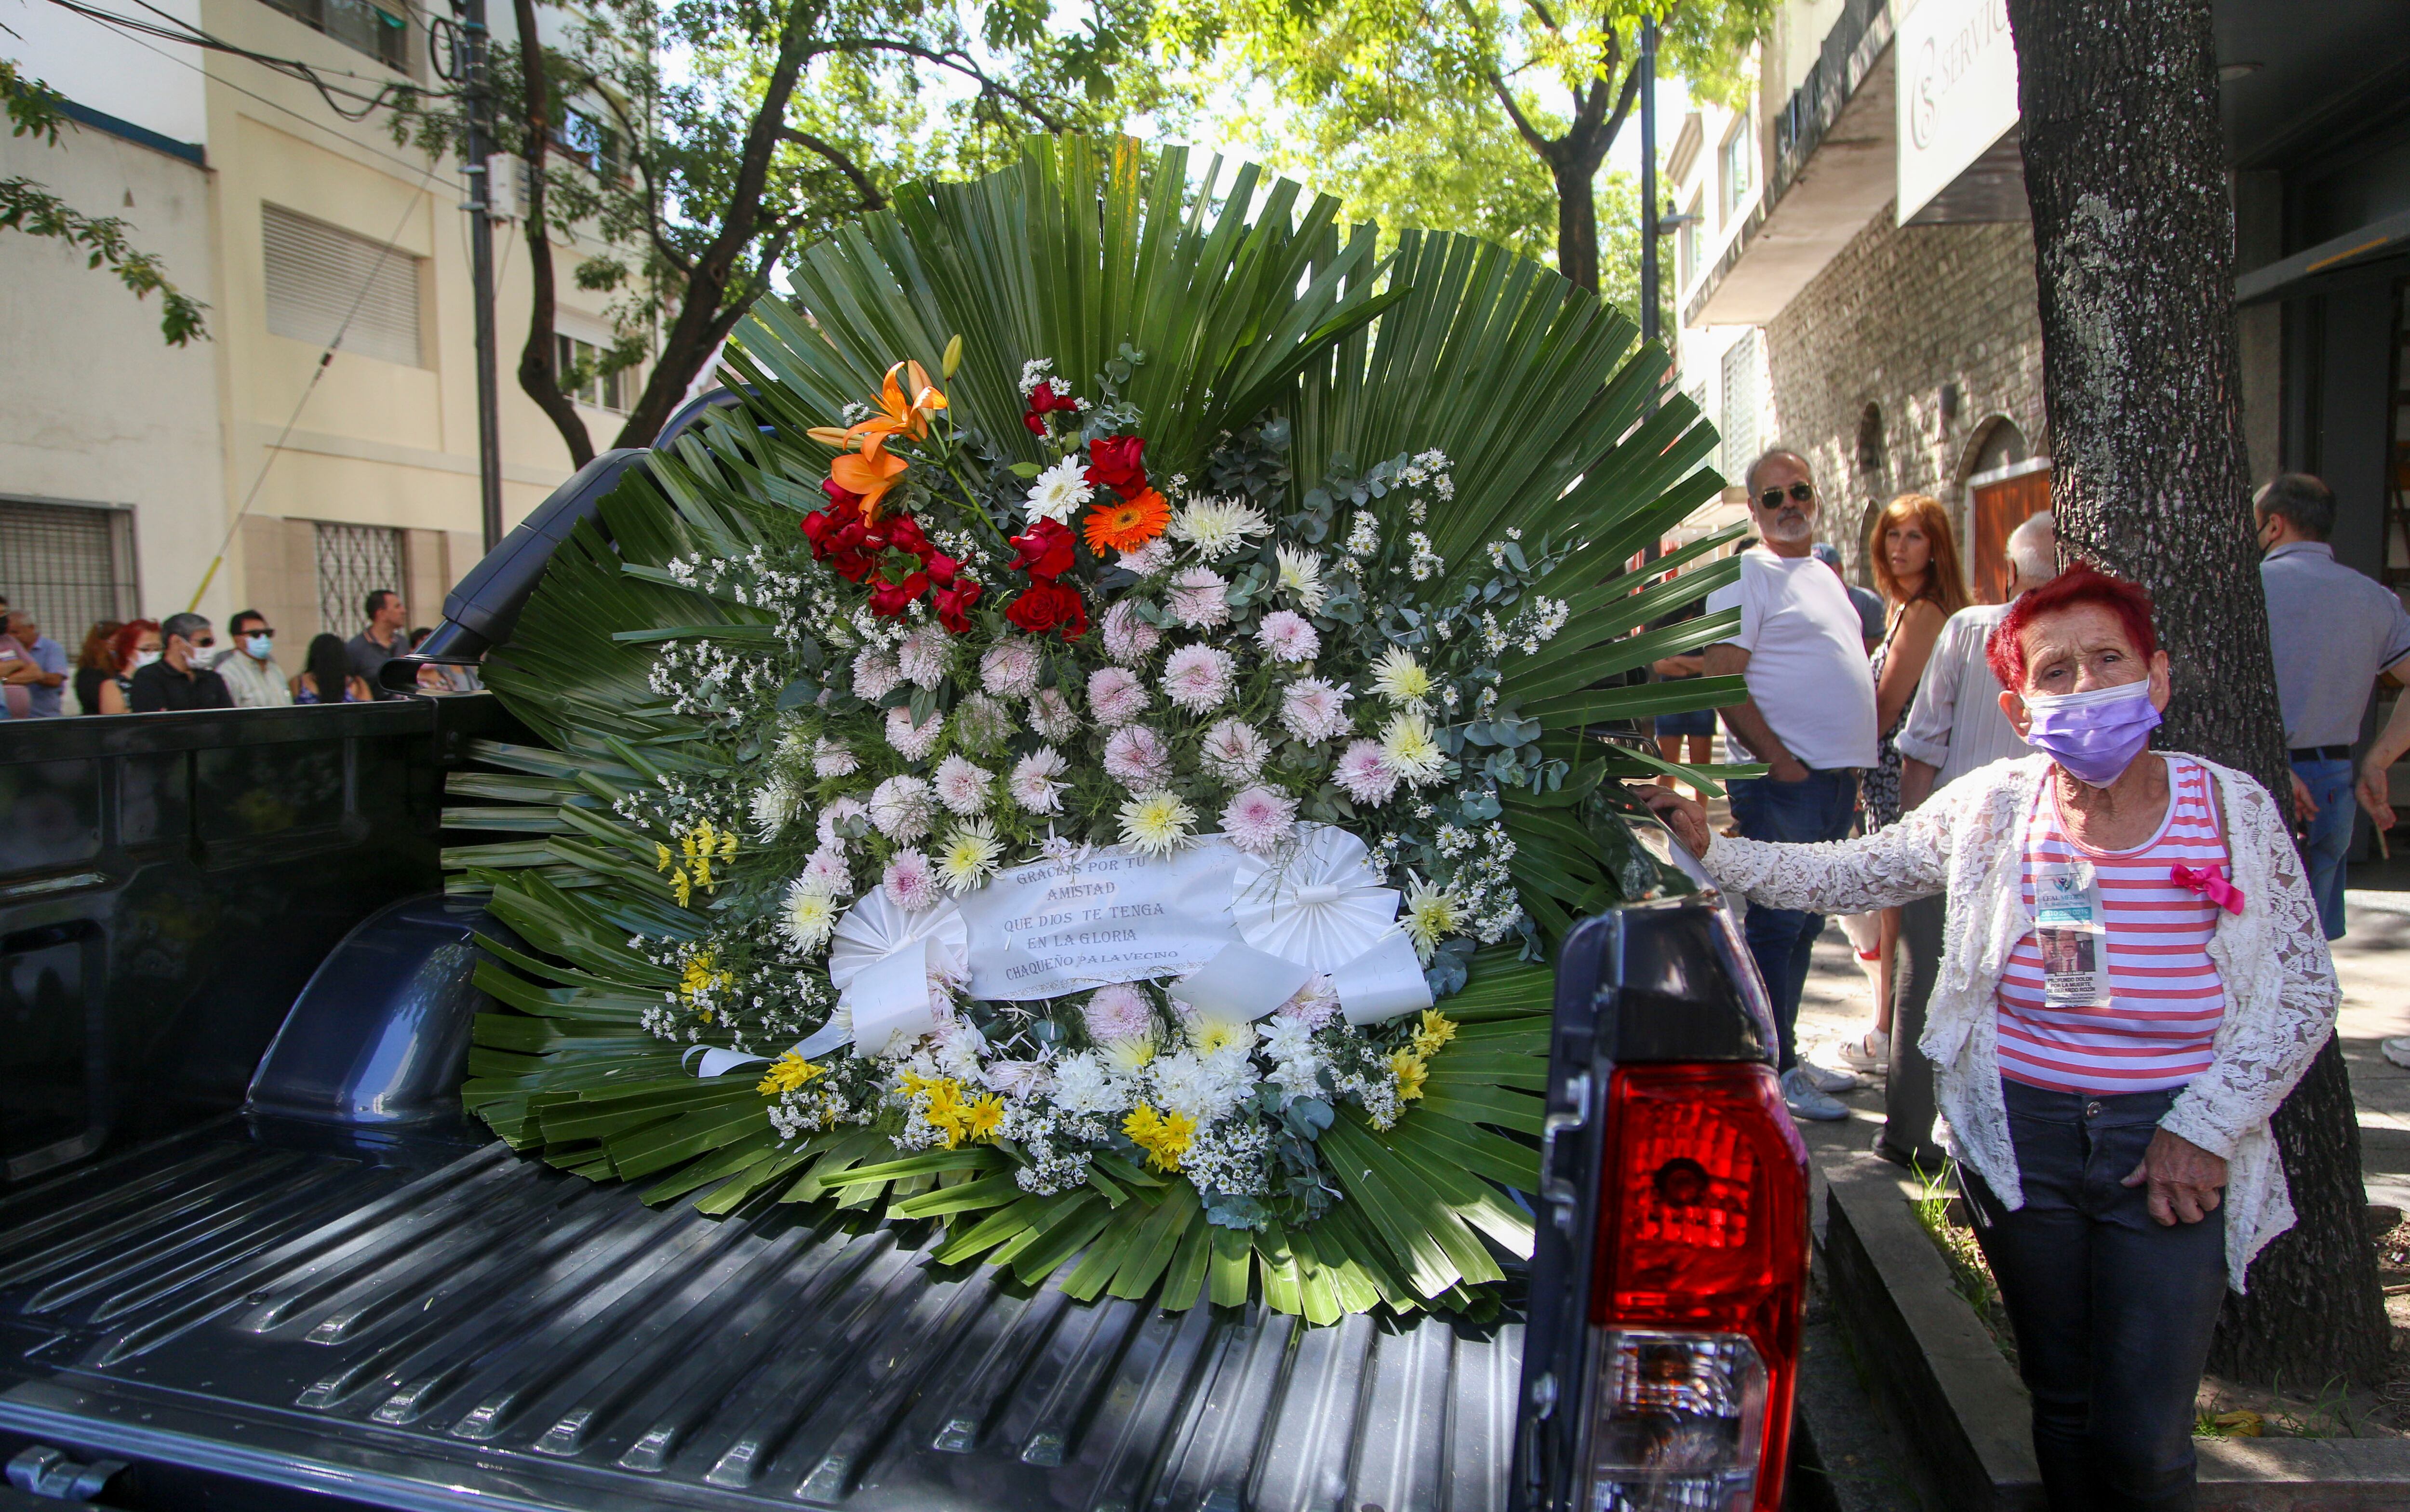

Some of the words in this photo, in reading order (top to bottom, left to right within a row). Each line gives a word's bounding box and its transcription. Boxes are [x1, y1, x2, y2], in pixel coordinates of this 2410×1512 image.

[1088, 860, 1119, 872] POR
[1125, 856, 1146, 868] TU
[1046, 882, 1115, 901] AMISTAD
[1004, 917, 1033, 933] QUE
[1039, 912, 1072, 927] DIOS
[1082, 909, 1101, 921] TE
[1109, 903, 1165, 919] TENGA
[1027, 936, 1047, 949] EN
[1054, 934, 1074, 947] LA
[1079, 929, 1138, 945] GLORIA
[1005, 954, 1073, 980] CHAQUEÑO
